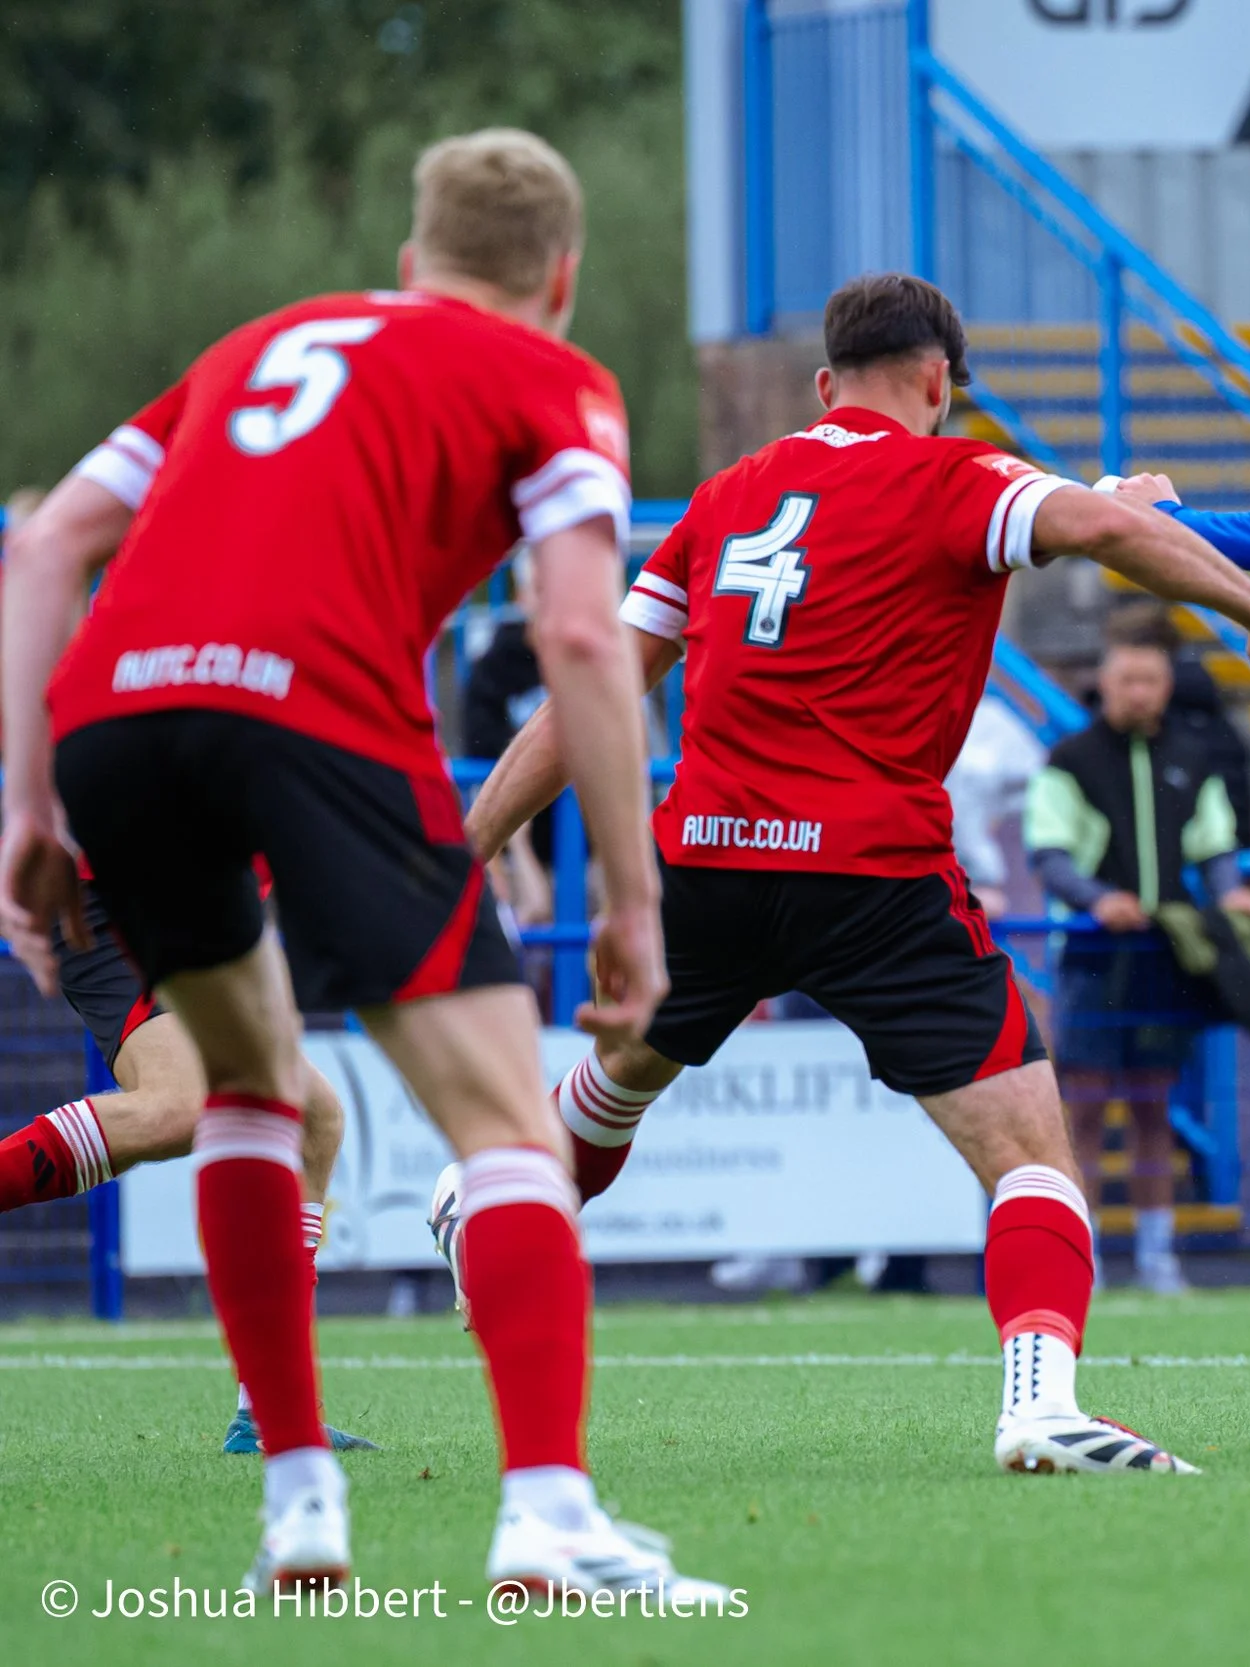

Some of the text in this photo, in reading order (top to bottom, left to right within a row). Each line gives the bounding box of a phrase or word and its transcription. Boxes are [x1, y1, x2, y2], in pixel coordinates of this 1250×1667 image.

[226, 316, 386, 456] 5
[712, 490, 820, 650] 4
[681, 814, 822, 853] AUITC.CO.UK
